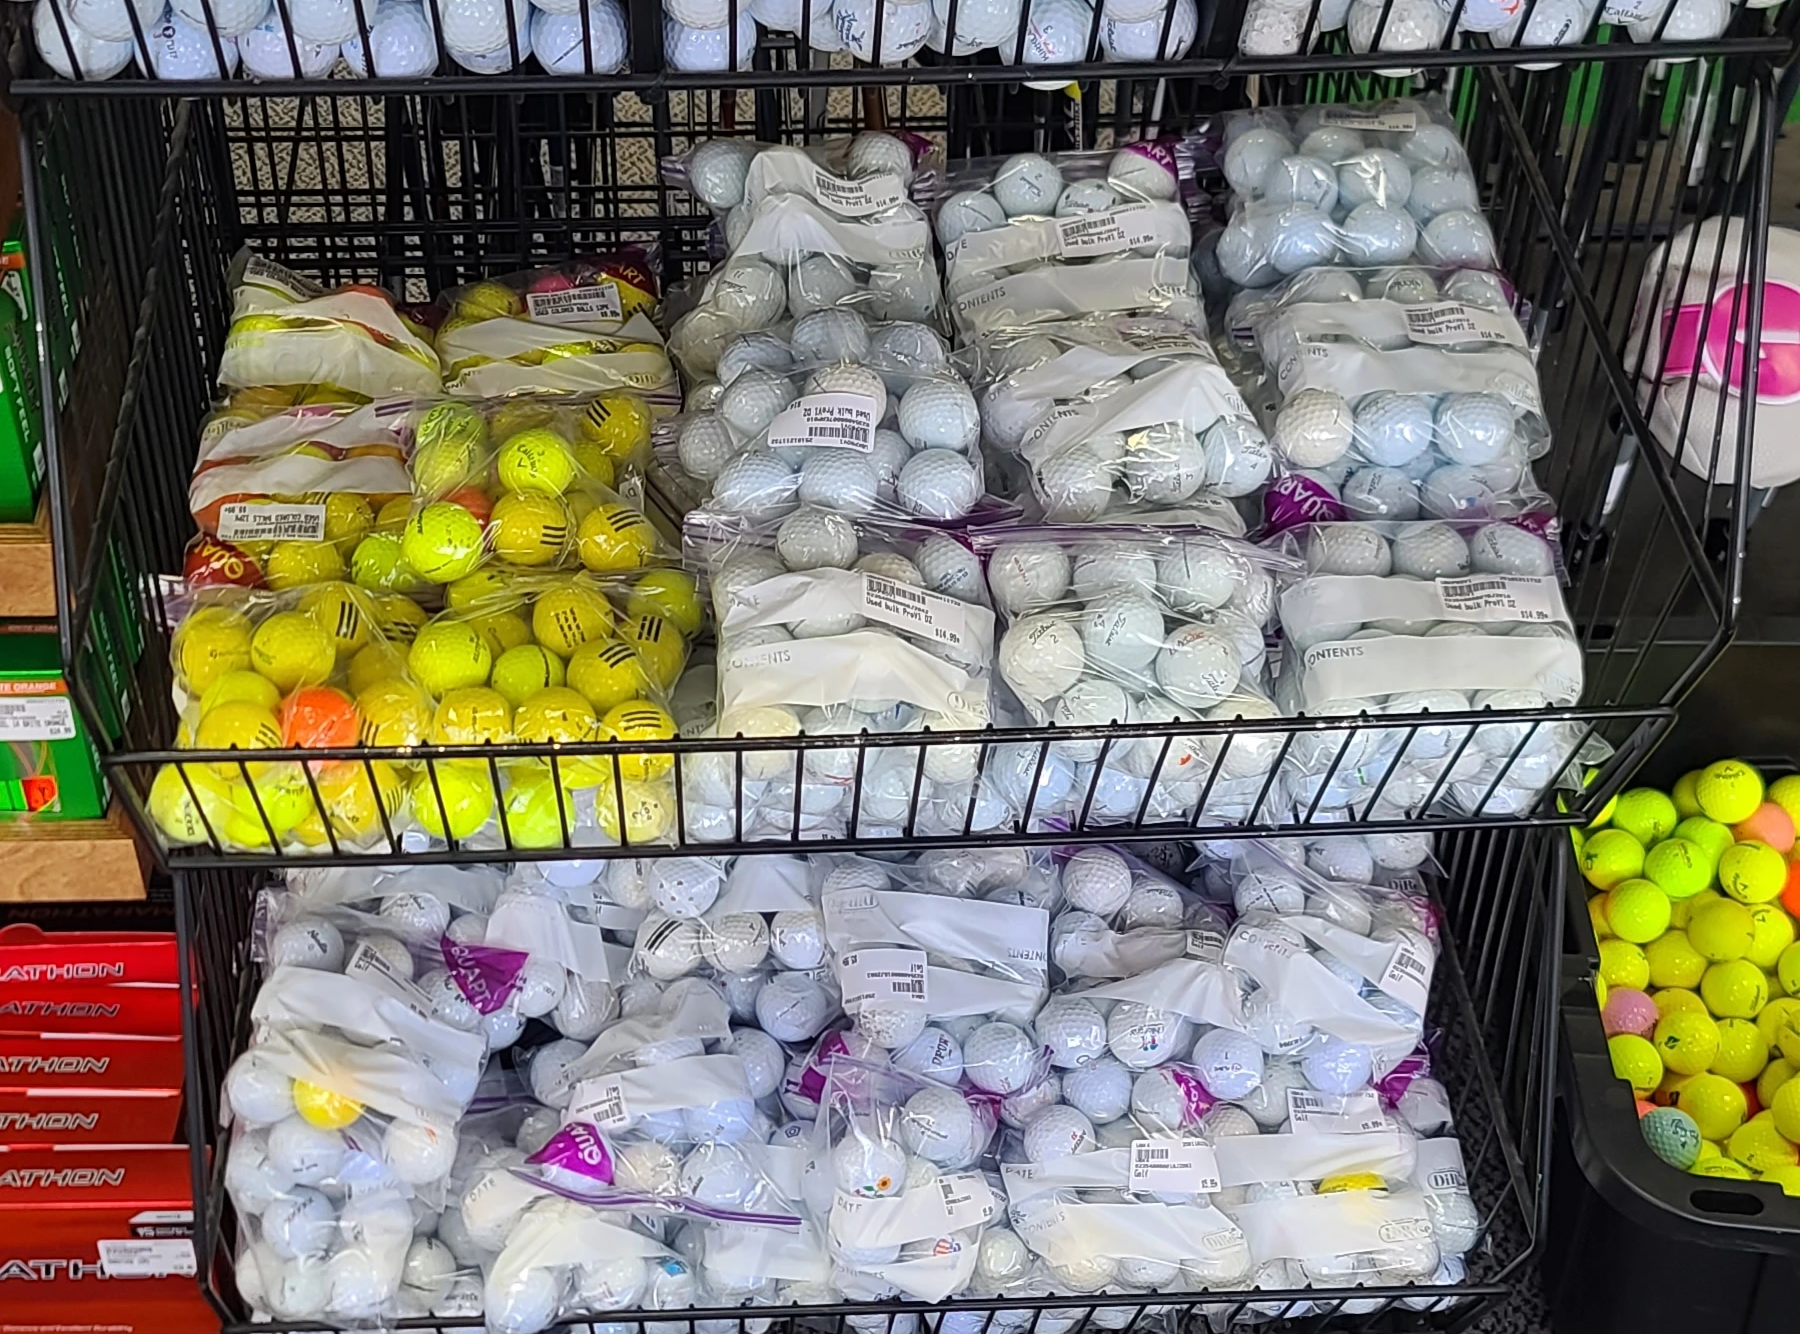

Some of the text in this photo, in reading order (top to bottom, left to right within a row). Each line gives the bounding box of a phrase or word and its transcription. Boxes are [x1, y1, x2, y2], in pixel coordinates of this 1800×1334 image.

[957, 285, 1006, 313] ONTENTS
[5, 345, 30, 444] SOFT FEEL
[803, 407, 870, 421] Used bulk ProV1 DZ
[866, 597, 882, 608] Used
[884, 601, 900, 614] bulk
[902, 608, 921, 621] ProV1
[925, 614, 933, 624] DZ
[13, 682, 57, 691] ORANGE
[0, 962, 124, 981] ATHON
[451, 944, 491, 1008] QUART
[1294, 1113, 1308, 1122] Golf
[1134, 1169, 1149, 1178] Golf
[469, 1180, 496, 1203] DATE
